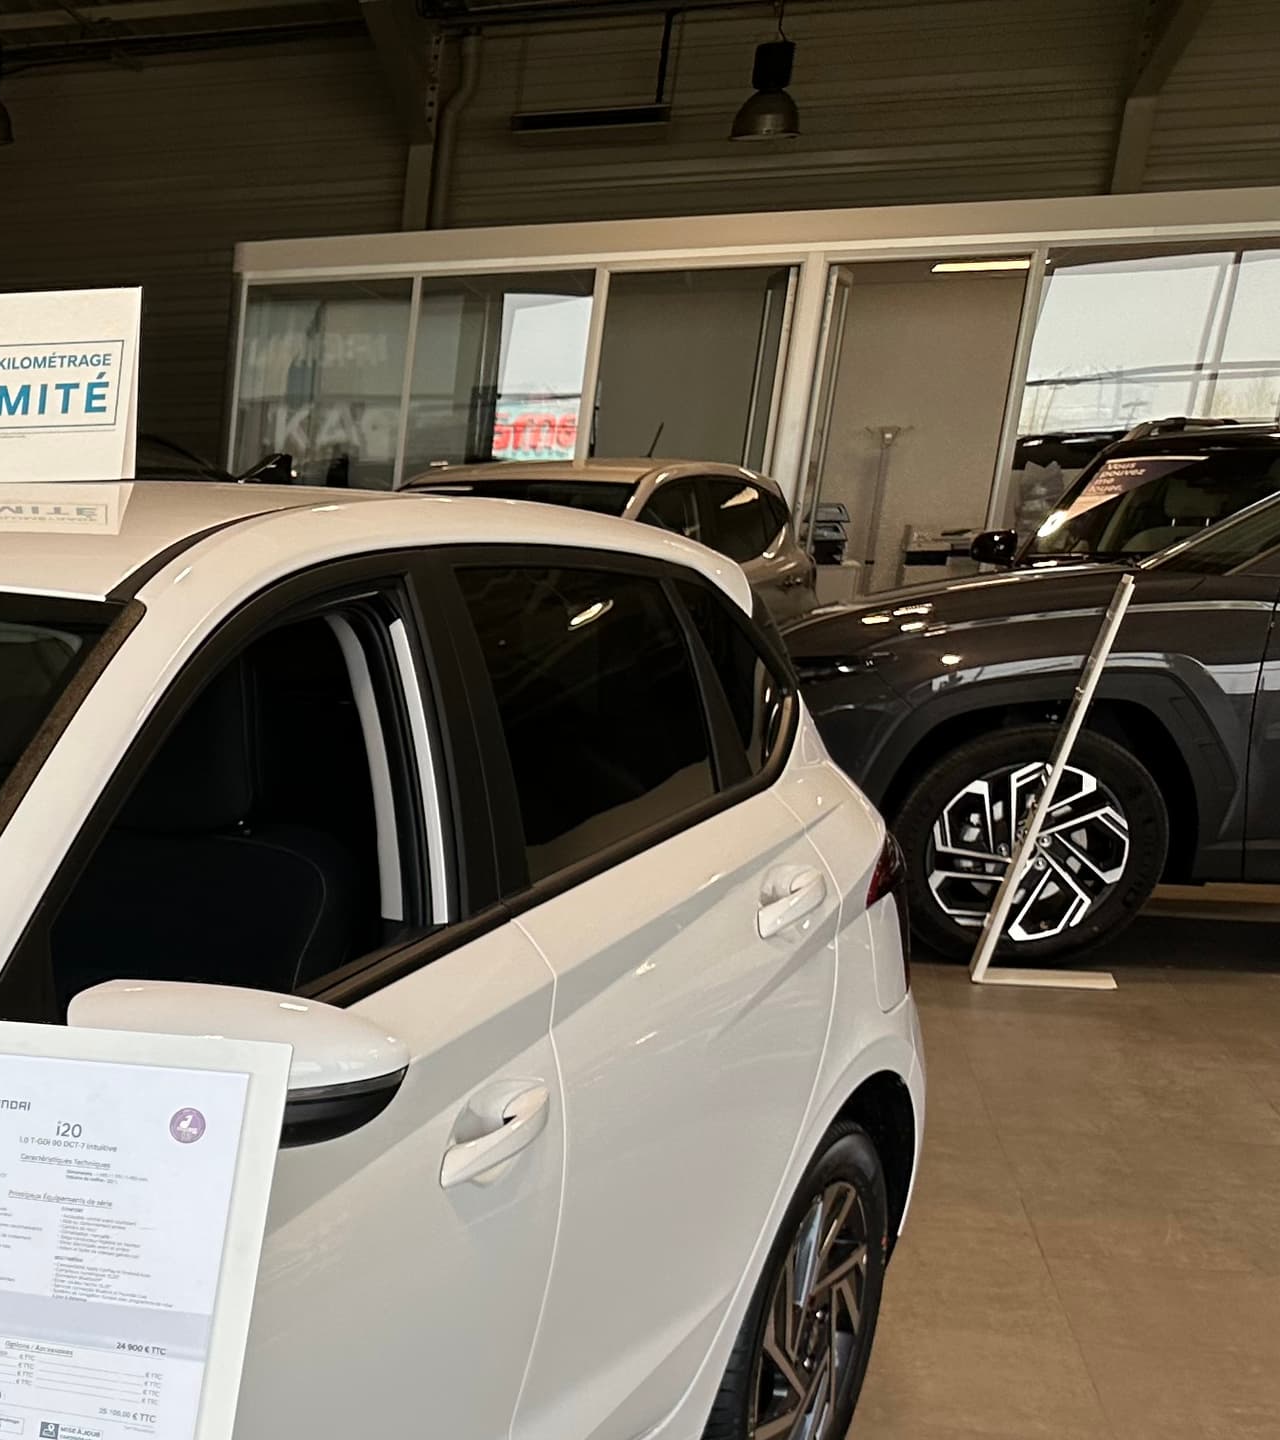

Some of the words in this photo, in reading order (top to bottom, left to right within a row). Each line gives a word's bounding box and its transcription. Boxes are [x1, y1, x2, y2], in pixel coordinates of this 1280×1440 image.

[56, 1121, 82, 1139] i20
[127, 1343, 143, 1353] 900
[145, 1345, 150, 1353] €
[151, 1346, 166, 1356] TTC
[132, 1412, 138, 1421] €
[139, 1414, 156, 1423] TTC
